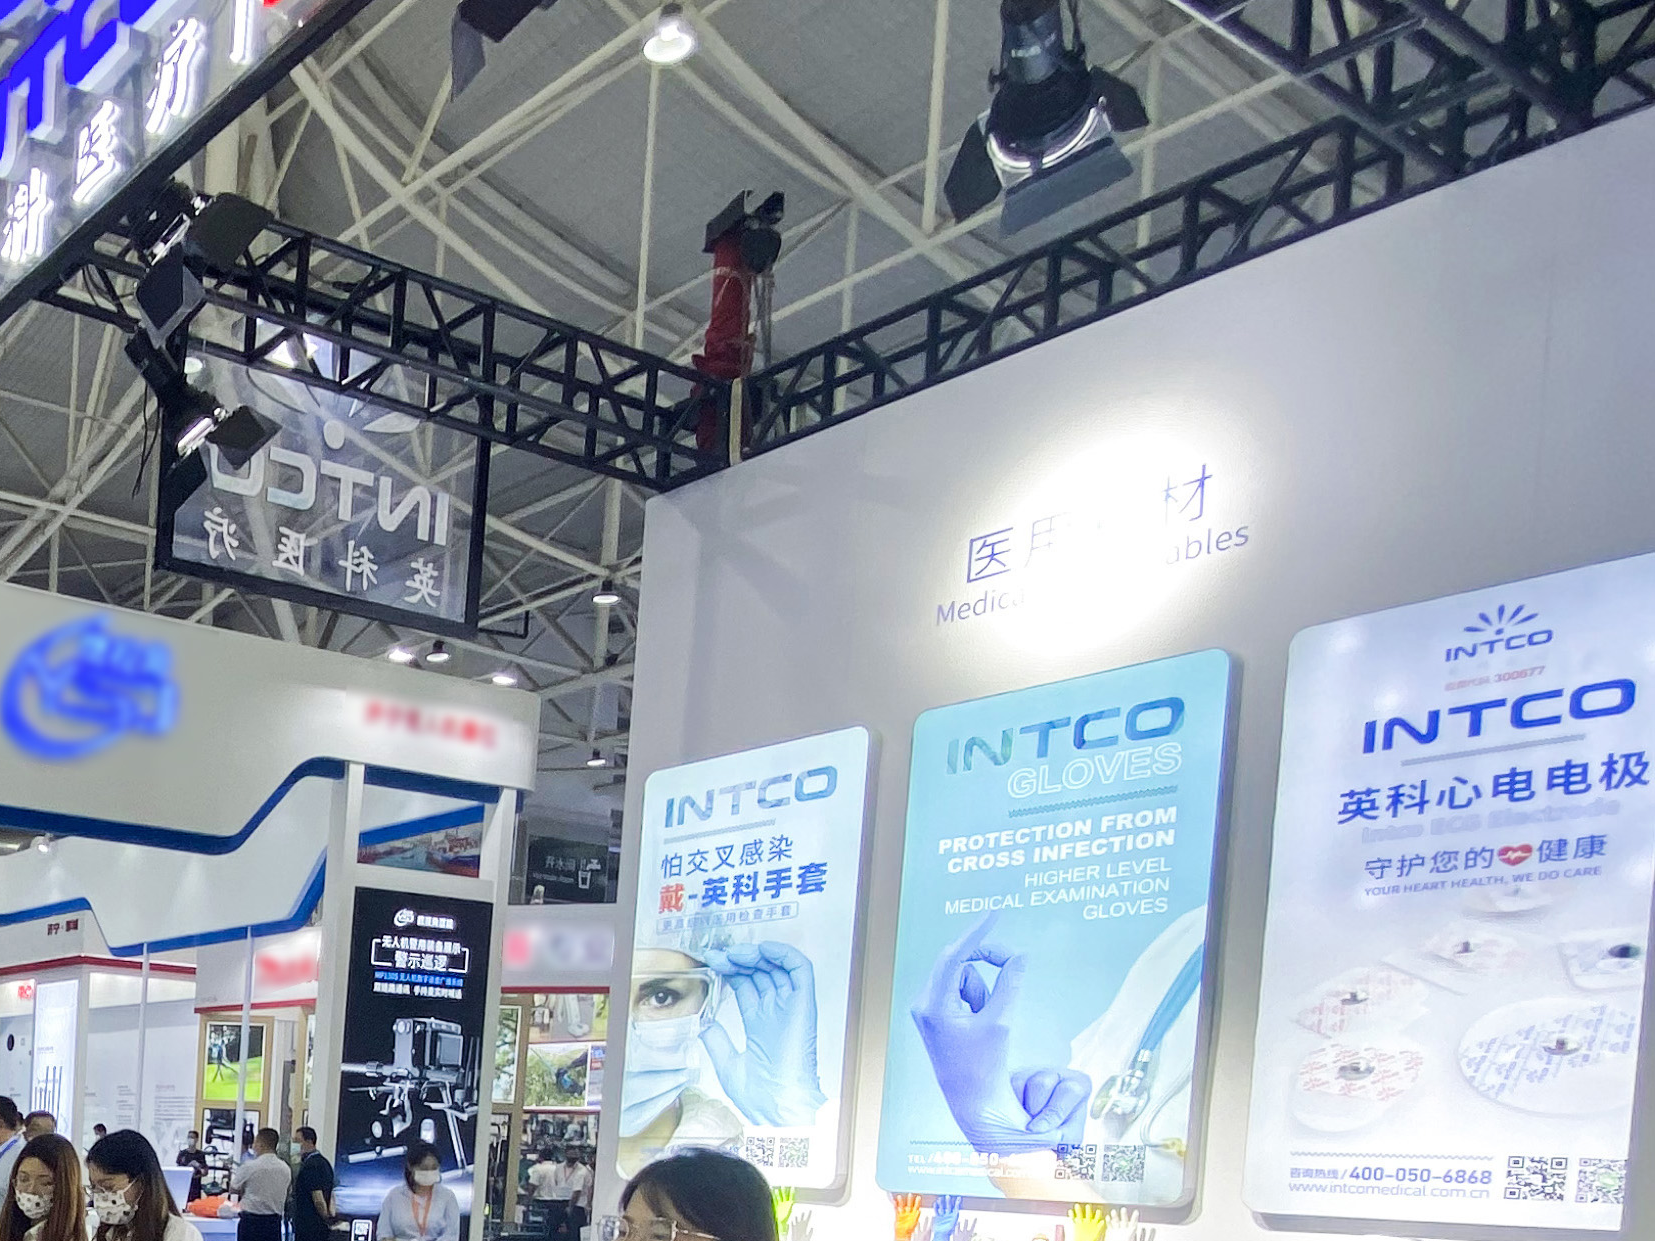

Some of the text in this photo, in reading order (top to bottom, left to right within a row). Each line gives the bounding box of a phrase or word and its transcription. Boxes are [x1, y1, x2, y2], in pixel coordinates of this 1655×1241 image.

[967, 463, 1212, 584] 医用材
[1445, 629, 1554, 662] INTCO
[947, 697, 1185, 775] INTCO
[1362, 678, 1637, 754] INTCO
[1008, 743, 1182, 798] GLOVES
[1337, 751, 1650, 825] 英科心电电极
[664, 765, 838, 828] INTCO
[938, 806, 1178, 855] PROTECTION FROM
[947, 829, 1175, 874] CROSS INFECTION
[661, 834, 793, 879] 怕交叉感染
[1024, 857, 1173, 888] HIGHER LEVEL
[944, 877, 1171, 915] MEDICAL EXAMINATION
[1365, 884, 1401, 897] YOUR
[1403, 881, 1447, 894] HEART
[1512, 872, 1534, 883] WE
[1537, 869, 1561, 881] DO
[1565, 866, 1603, 879] CARE
[1083, 897, 1169, 920] GLOVES
